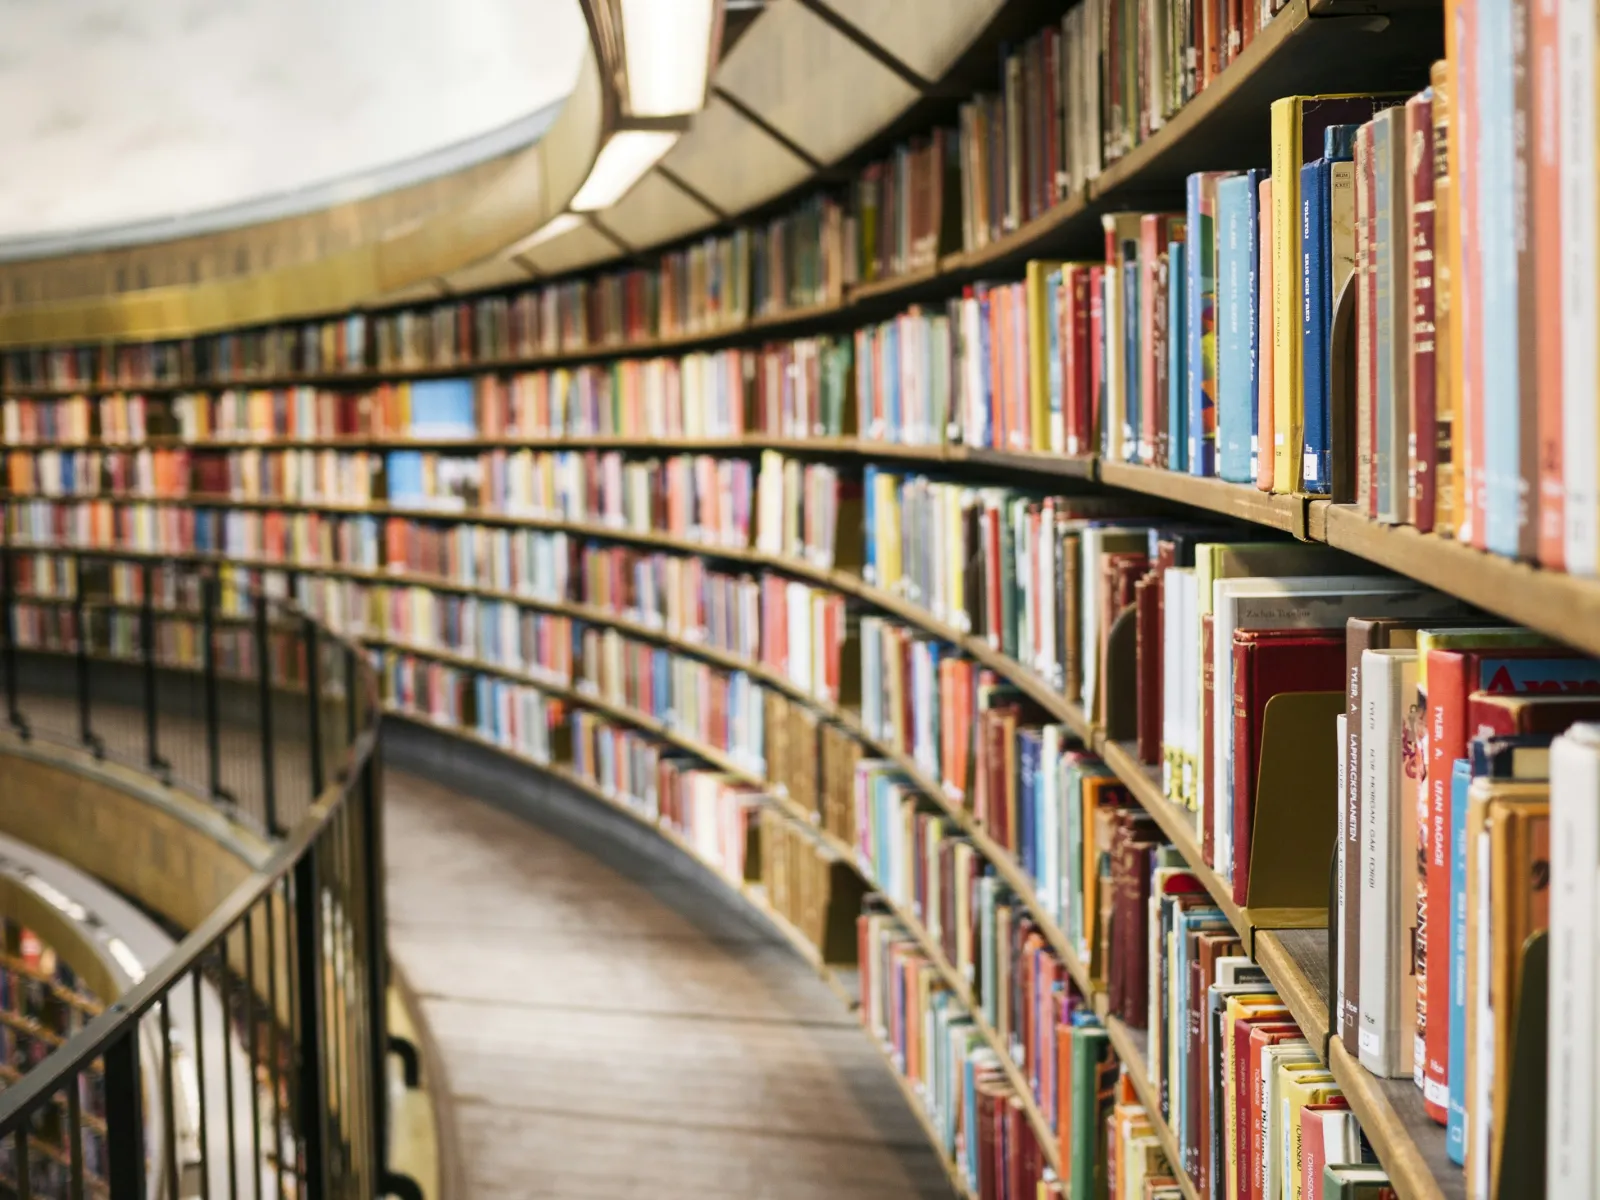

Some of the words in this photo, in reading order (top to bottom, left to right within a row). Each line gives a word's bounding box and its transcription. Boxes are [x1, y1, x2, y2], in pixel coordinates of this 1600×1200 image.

[1350, 666, 1359, 698] TYLER,
[1350, 703, 1359, 716] A.
[1369, 701, 1377, 731] TYLER
[1433, 705, 1444, 743] TYLER,
[1433, 780, 1444, 812] UTAN
[1434, 815, 1445, 868] BAGAGE
